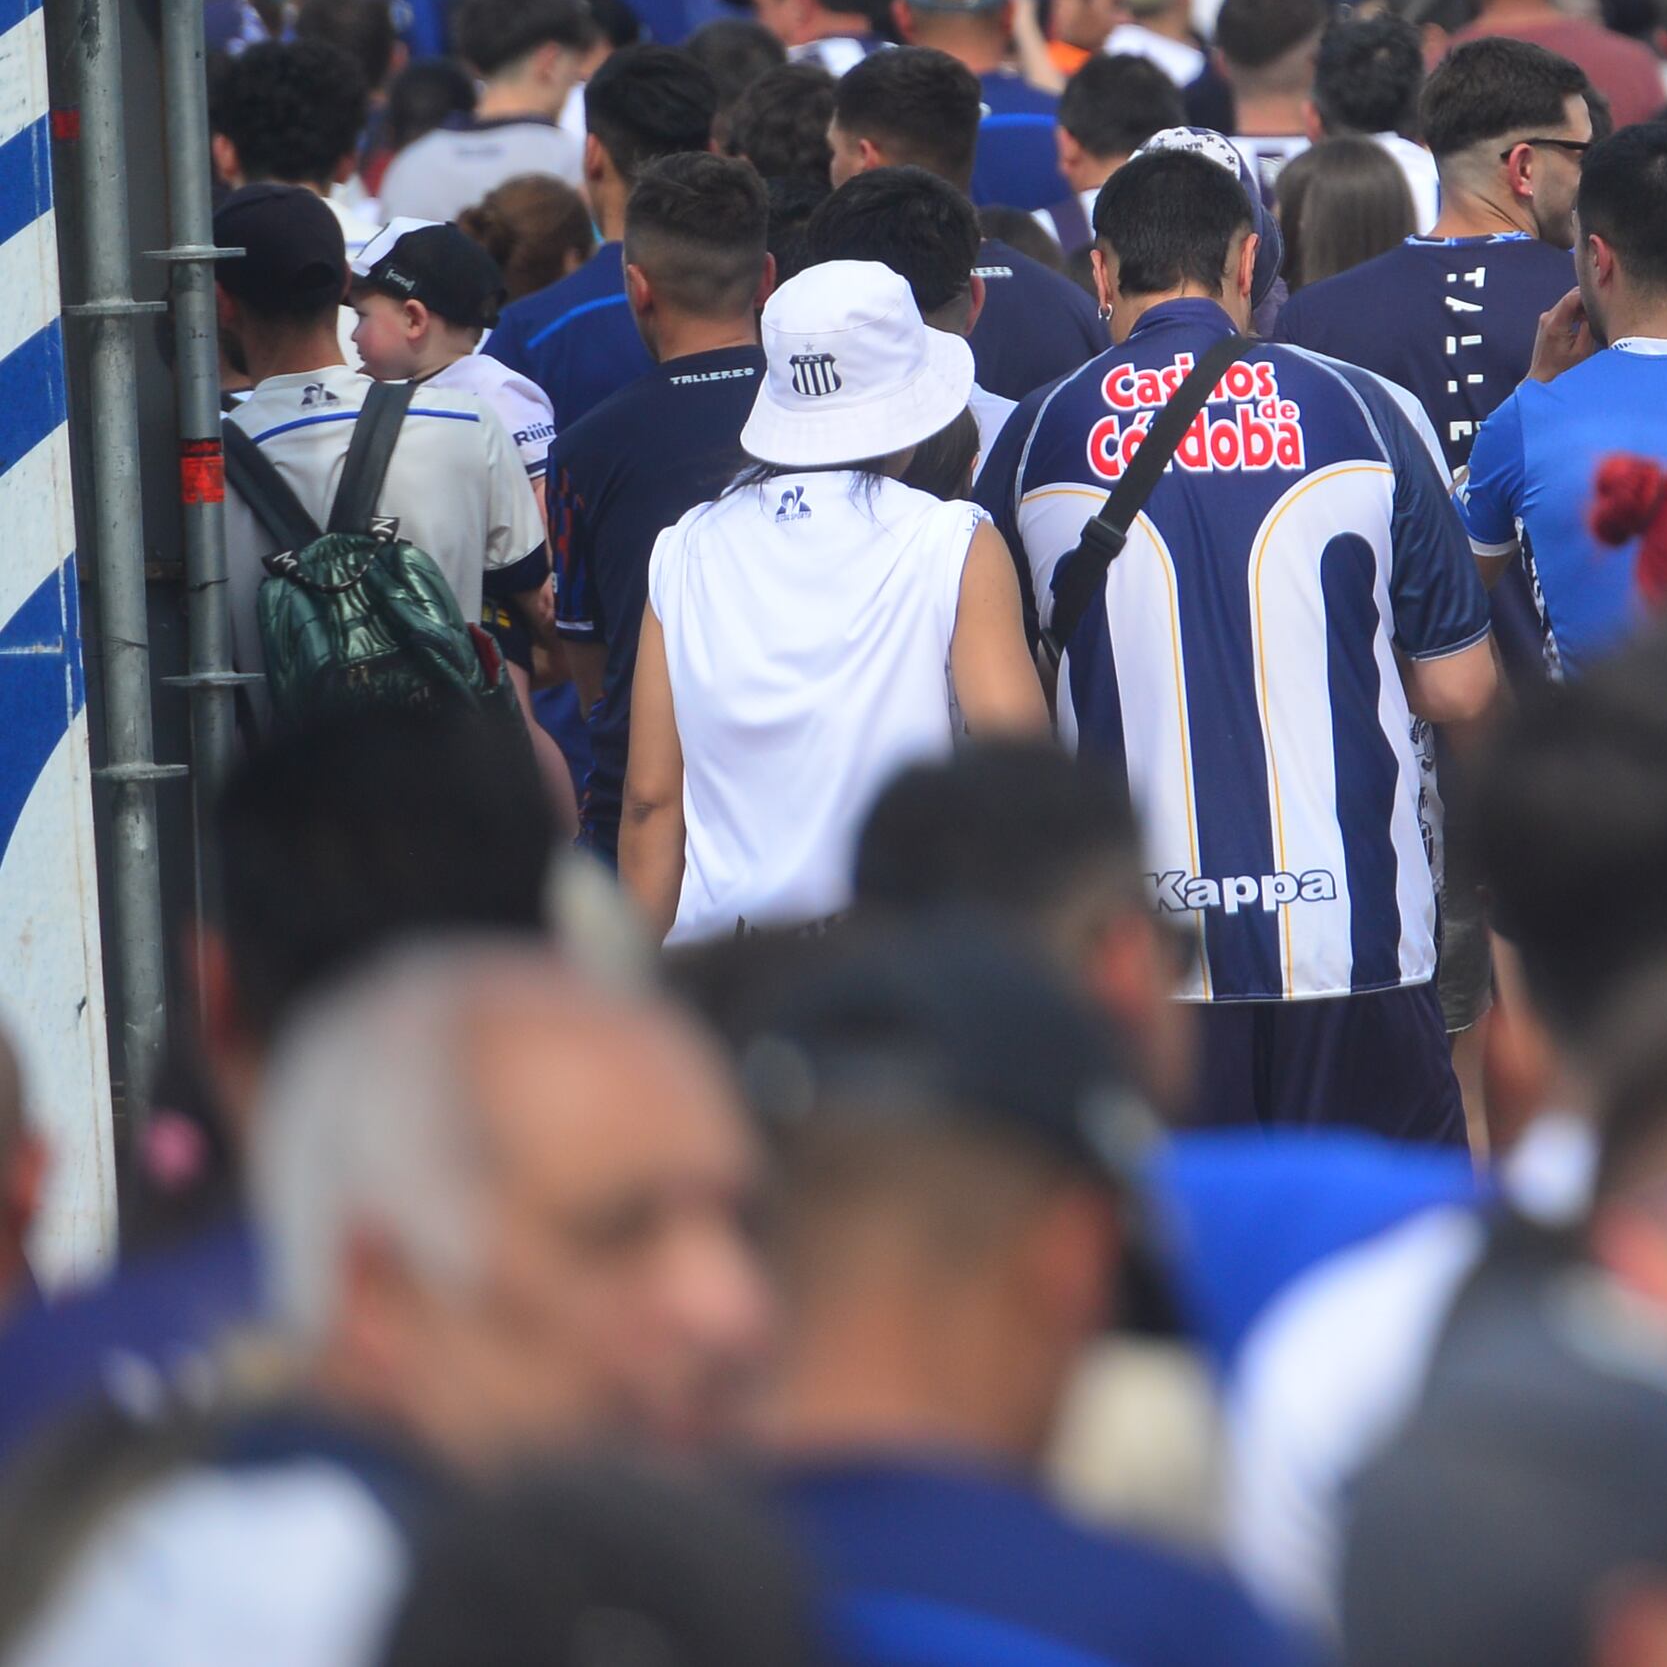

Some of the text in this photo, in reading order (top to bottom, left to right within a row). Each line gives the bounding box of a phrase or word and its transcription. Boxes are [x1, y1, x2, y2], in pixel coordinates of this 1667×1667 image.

[669, 367, 755, 385] TALLERES
[1257, 397, 1300, 420] de
[1087, 403, 1306, 481] Códoba
[1145, 869, 1338, 914] Kappa
